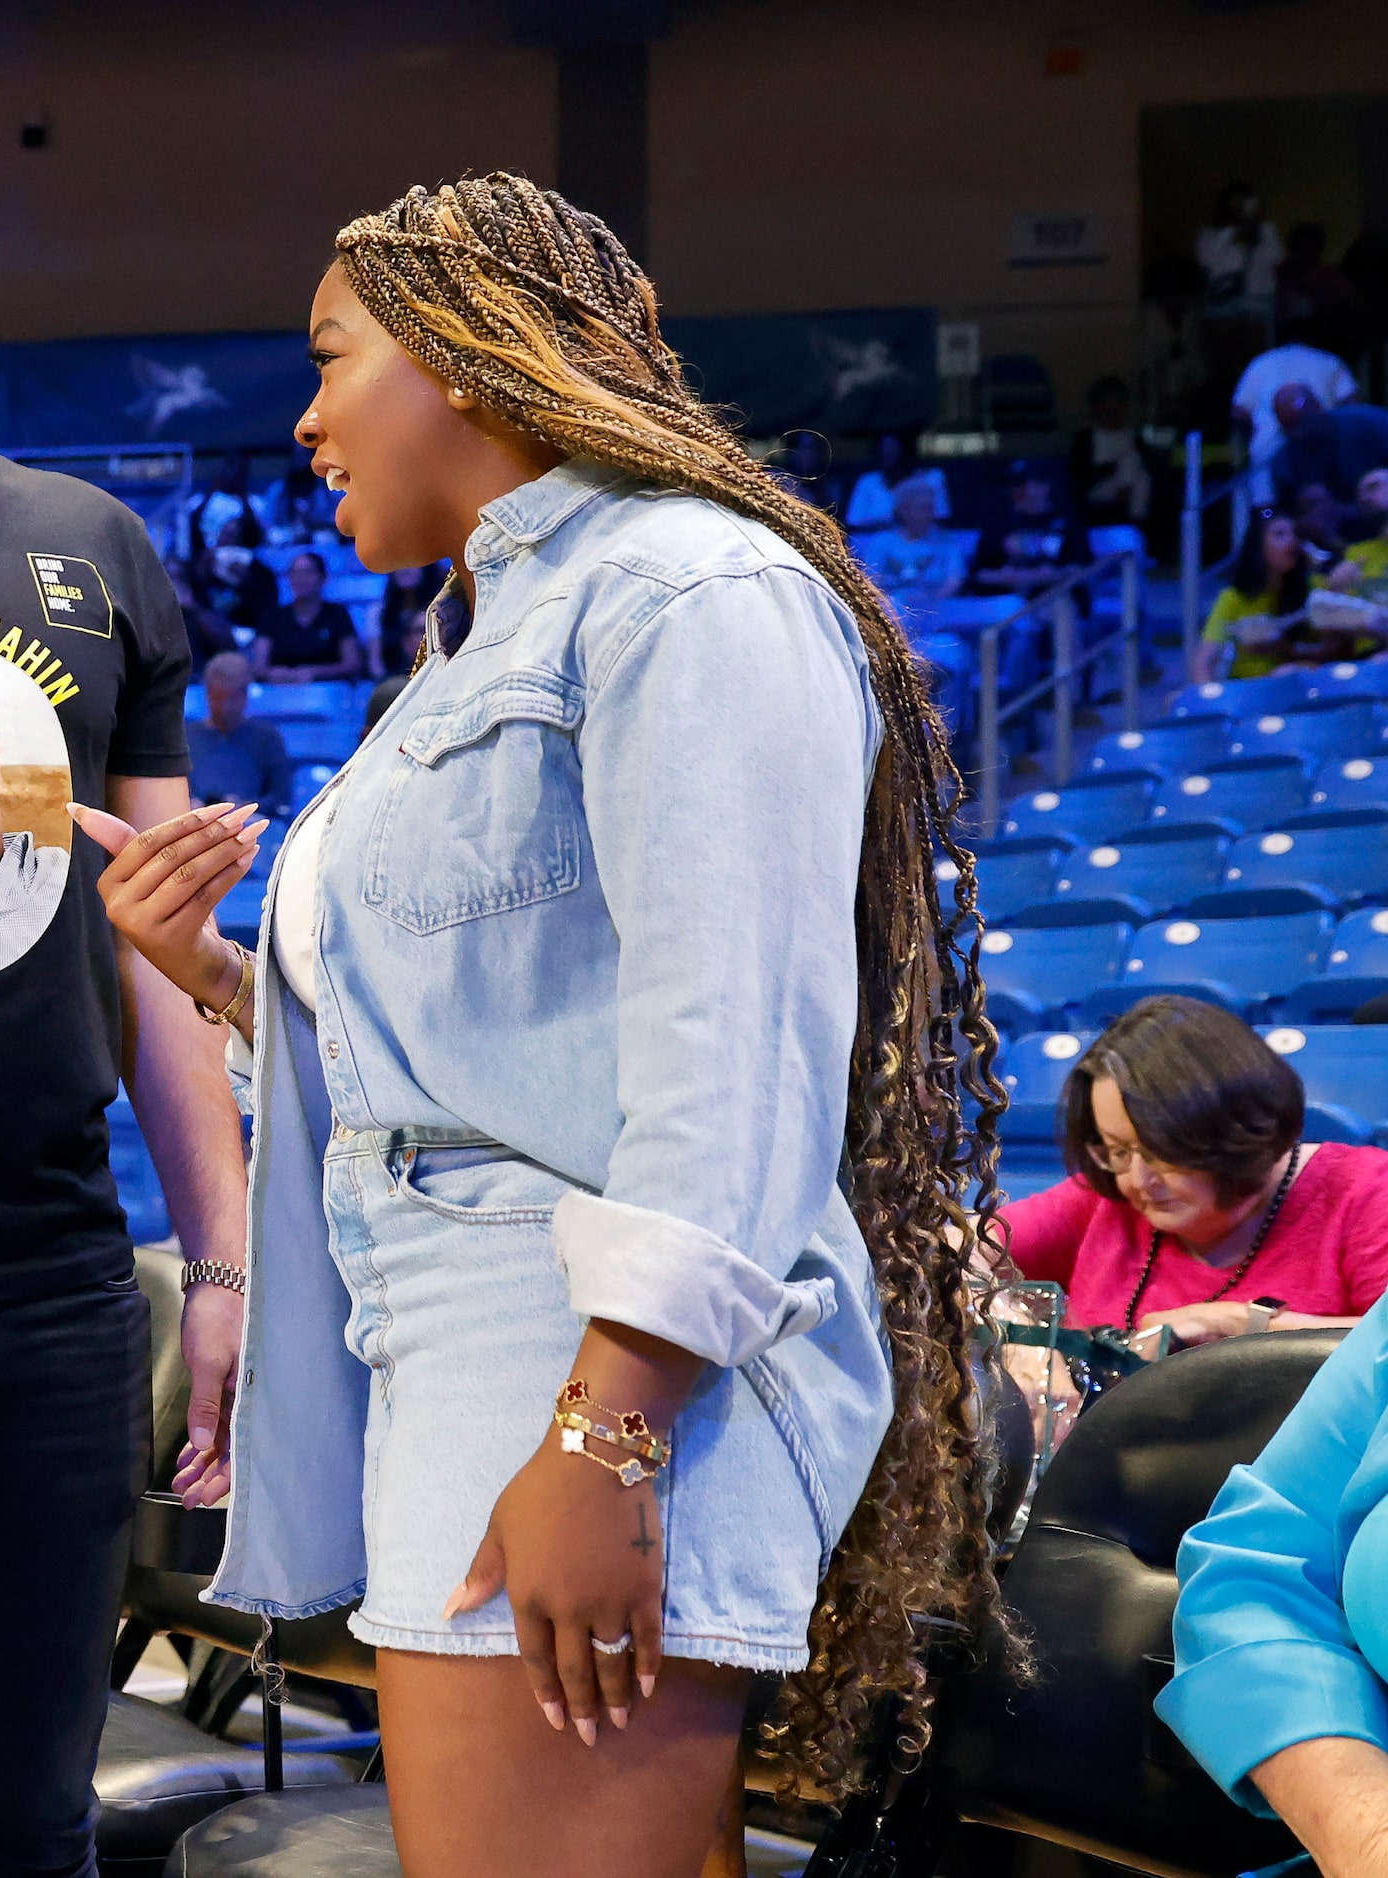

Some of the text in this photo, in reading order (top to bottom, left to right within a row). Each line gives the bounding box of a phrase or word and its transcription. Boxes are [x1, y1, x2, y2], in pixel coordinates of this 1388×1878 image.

[35, 558, 64, 572] BRING
[39, 570, 61, 584] OUR
[43, 583, 84, 601] FAMILIES
[46, 598, 75, 612] HOME.
